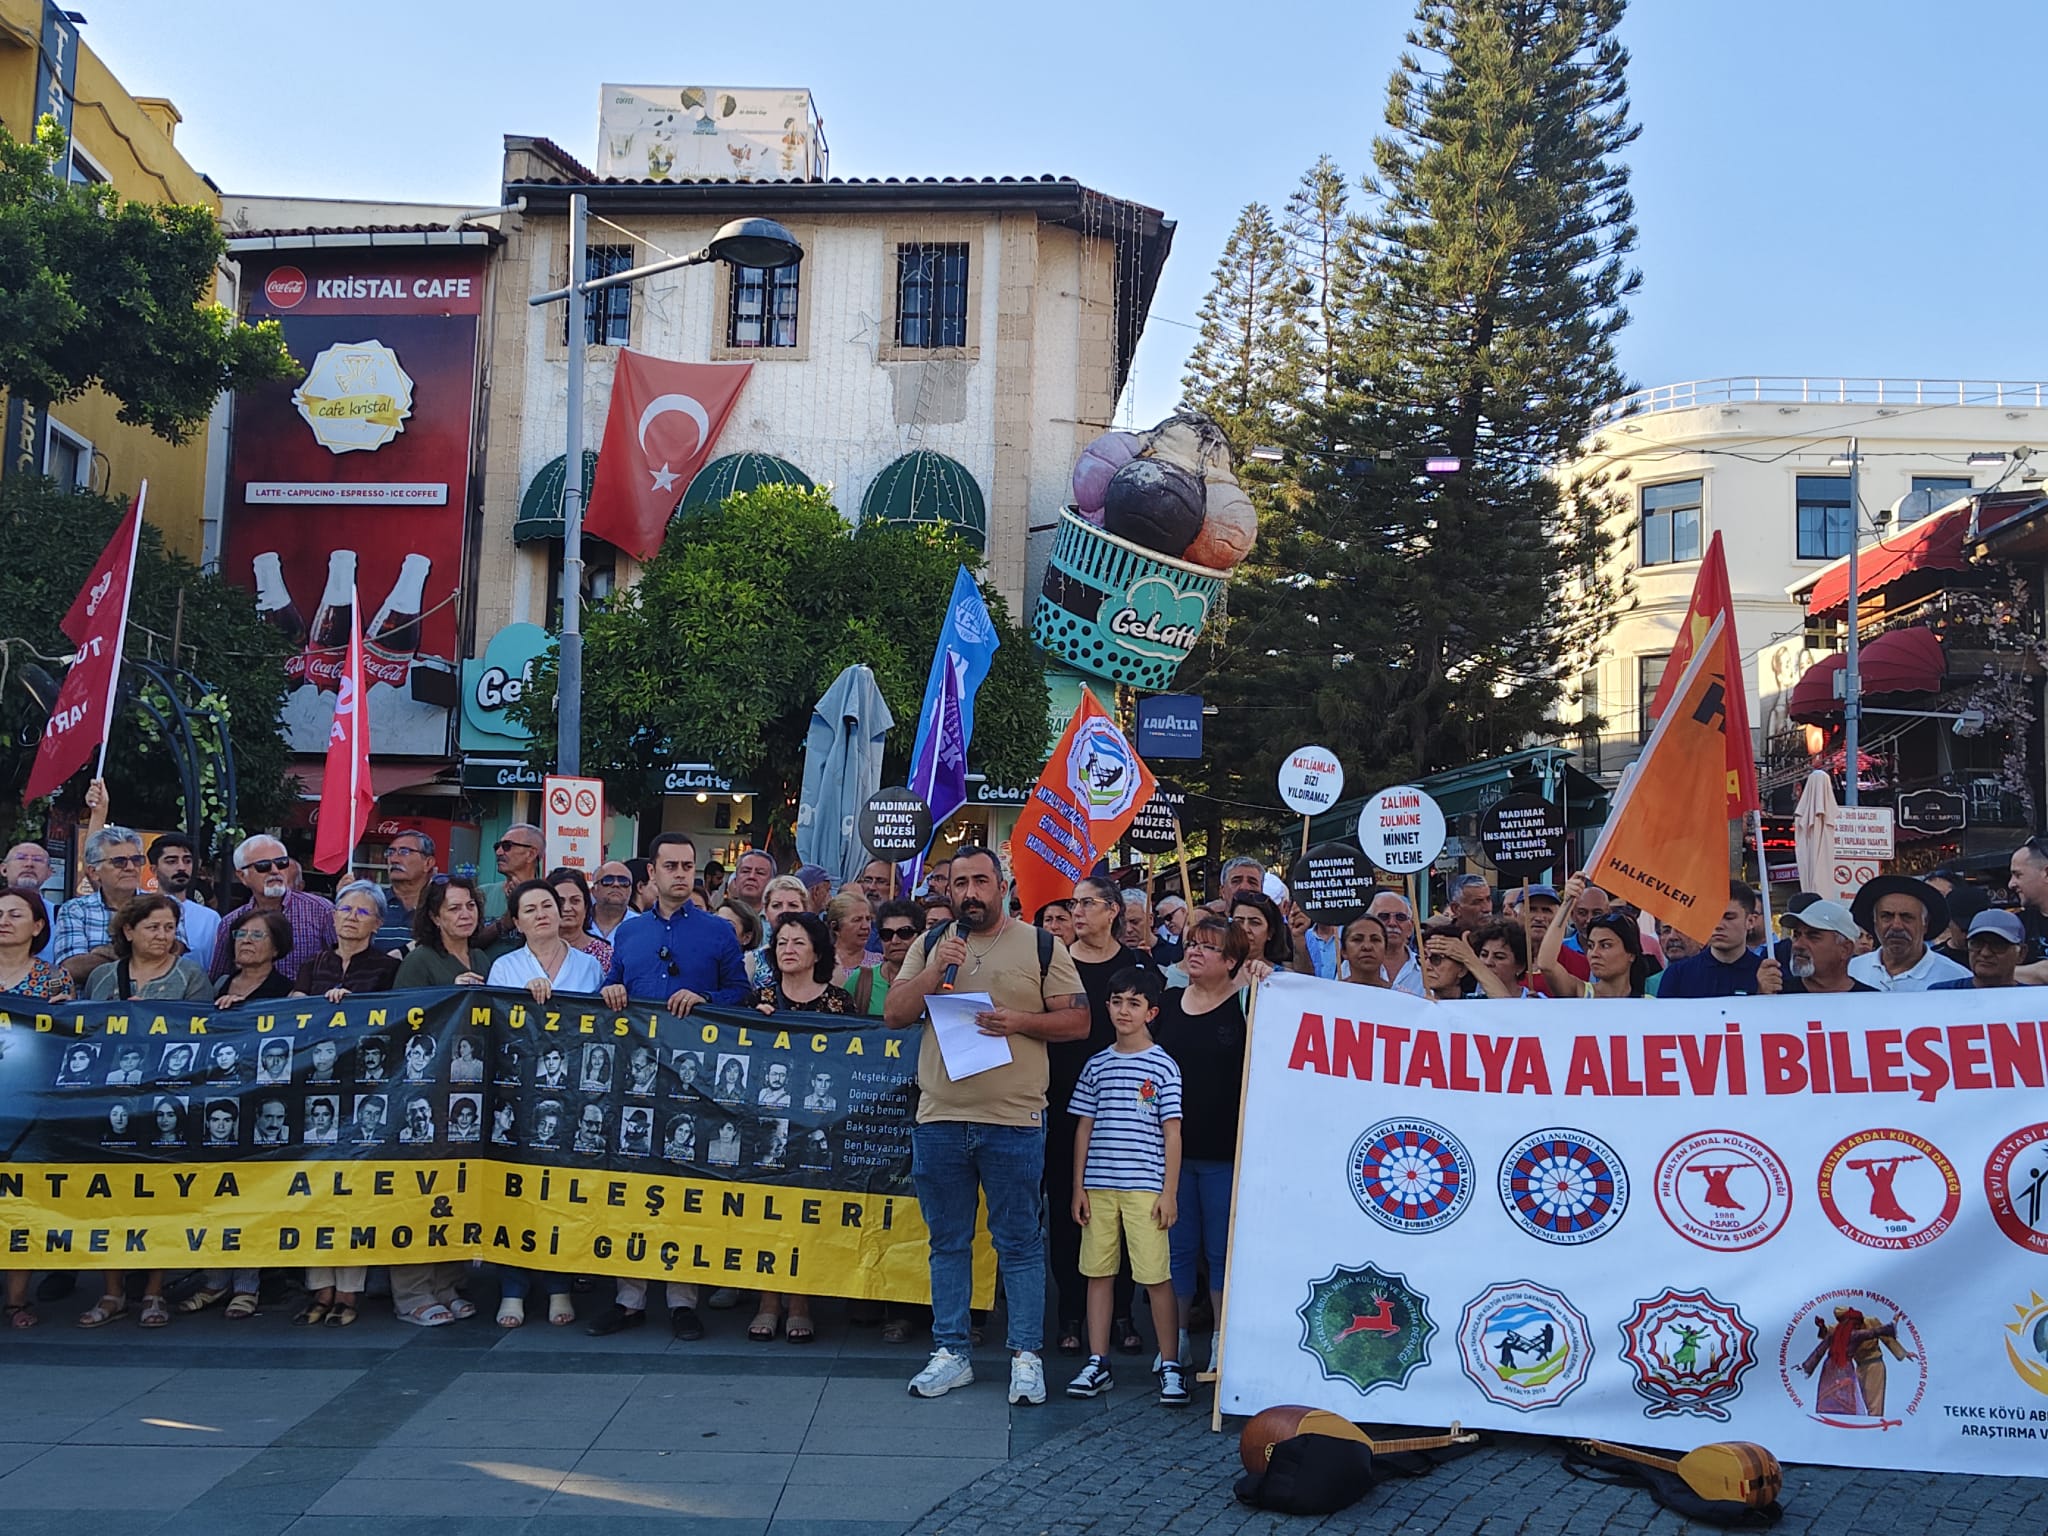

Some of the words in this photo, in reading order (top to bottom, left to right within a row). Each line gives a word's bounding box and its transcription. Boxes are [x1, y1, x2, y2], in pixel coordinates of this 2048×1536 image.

[316, 275, 407, 299] KRİSTAL
[412, 279, 471, 299] CAFE
[318, 401, 345, 417] cafe
[349, 398, 391, 417] kristal
[255, 489, 281, 497] LATTE
[287, 489, 335, 498] CAPPUCINO
[341, 490, 384, 498] ESPRESSO
[391, 490, 403, 498] ICE
[405, 490, 438, 498] COFFEE
[1143, 705, 1198, 731] LAVAZZA
[1292, 756, 1336, 774] KATLİAMLAR
[1304, 771, 1319, 787] BİZİ
[1287, 786, 1330, 804] YILDIRAMAZ
[1381, 791, 1420, 809] ZALİMİN
[870, 801, 922, 812] MADIMAK
[1498, 808, 1545, 819] MADIMAK
[877, 814, 913, 826] UTANÇ
[1380, 813, 1421, 828] ZULMÜNE
[1500, 818, 1545, 829] KATLİAMI
[874, 825, 915, 836] MÜZESİ
[1131, 829, 1175, 841] OLACAK
[1383, 828, 1420, 846] MİNNET
[1483, 831, 1533, 841] İNSANLIĞA
[1535, 826, 1564, 837] KARŞI
[873, 838, 916, 849] OLACAK
[1309, 858, 1354, 868] MADIMAK
[1385, 851, 1423, 866] EYLEME
[1495, 852, 1512, 861] BİR
[1310, 867, 1354, 879] KATLİAMI
[1294, 879, 1343, 890] İNSANLIĞA
[1345, 877, 1373, 888] KARŞI
[1609, 857, 1697, 908] HALKEVLERİ
[1305, 900, 1323, 910] BİR
[0, 1013, 209, 1035] ADIMAK
[256, 1007, 425, 1034] UTANÇ
[471, 1005, 658, 1039] MÜZESİ
[701, 1024, 903, 1059] OLACAK
[1288, 1012, 1553, 1096] ANTALYA
[1565, 1023, 1748, 1097] ALEVİ
[849, 1088, 879, 1102] Dönüp
[880, 1091, 908, 1103] duran
[846, 1120, 863, 1132] Bak
[1398, 1123, 1444, 1141] ANADOLU
[844, 1139, 862, 1150] Ben
[1688, 1137, 1720, 1152] ABDAL
[1822, 1144, 1848, 1179] SULTAN
[1848, 1131, 1886, 1148] ABDAL
[1889, 1131, 1932, 1154] KÜLTÜR
[0, 1171, 240, 1199] NTALYA
[287, 1162, 468, 1199] ALEVİ
[430, 1195, 454, 1219] &
[505, 1168, 893, 1231] BİLEŞENLERİ
[1682, 1222, 1731, 1242] ANTALYA
[1839, 1223, 1904, 1249] ALTINOVA
[1885, 1225, 1908, 1233] 1988
[8, 1228, 150, 1253] EMEK
[186, 1226, 242, 1252] VE
[279, 1222, 559, 1256] DEMOKRASİ
[593, 1231, 800, 1279] GÜÇLERİ
[1943, 1405, 1986, 1419] TEKKE
[1989, 1405, 2026, 1420] KÖYÜ
[1961, 1424, 2037, 1439] ARAŞTIRMA
